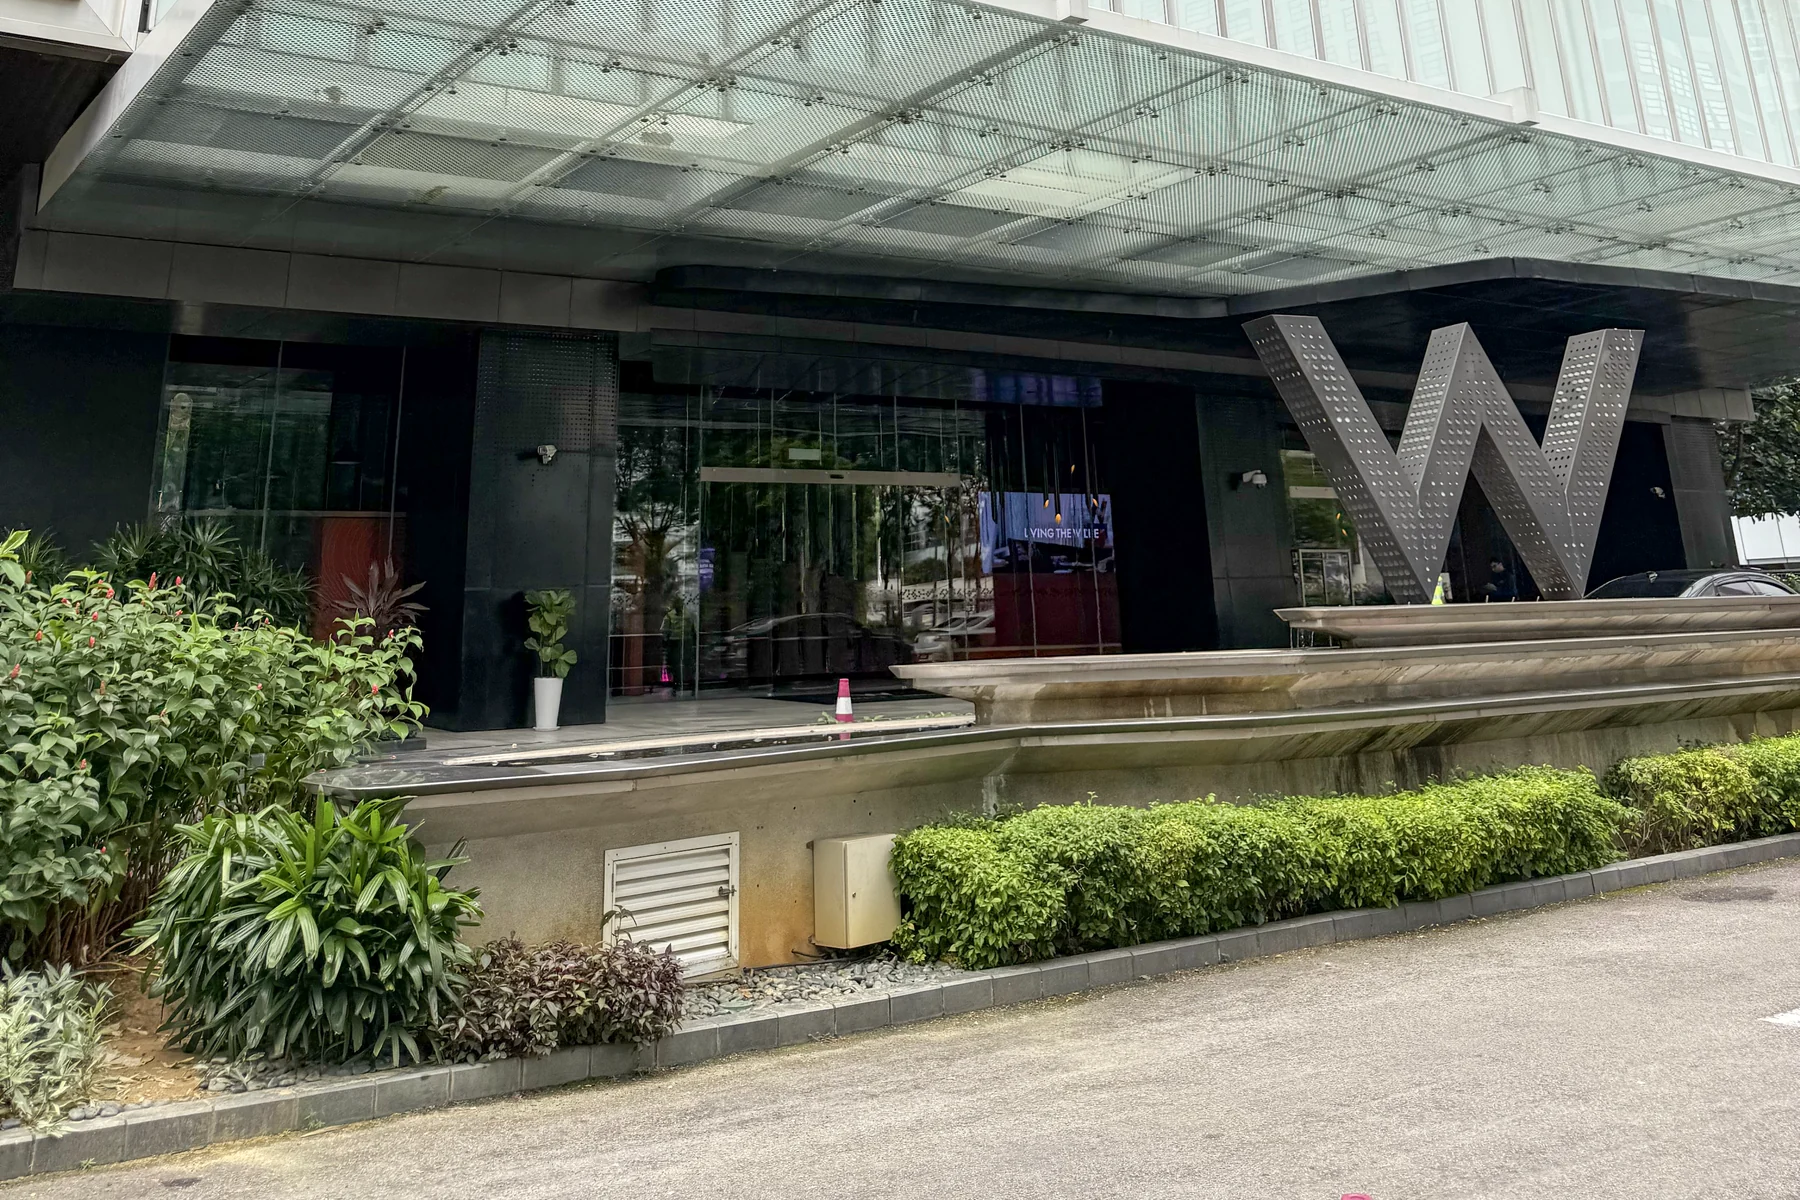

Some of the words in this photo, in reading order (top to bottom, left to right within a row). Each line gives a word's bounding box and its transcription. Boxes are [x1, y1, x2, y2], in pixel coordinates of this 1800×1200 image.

[1024, 528, 1055, 538] LVING
[1056, 528, 1072, 538] THE
[1083, 528, 1099, 539] LIE
[1241, 315, 1645, 604] W
